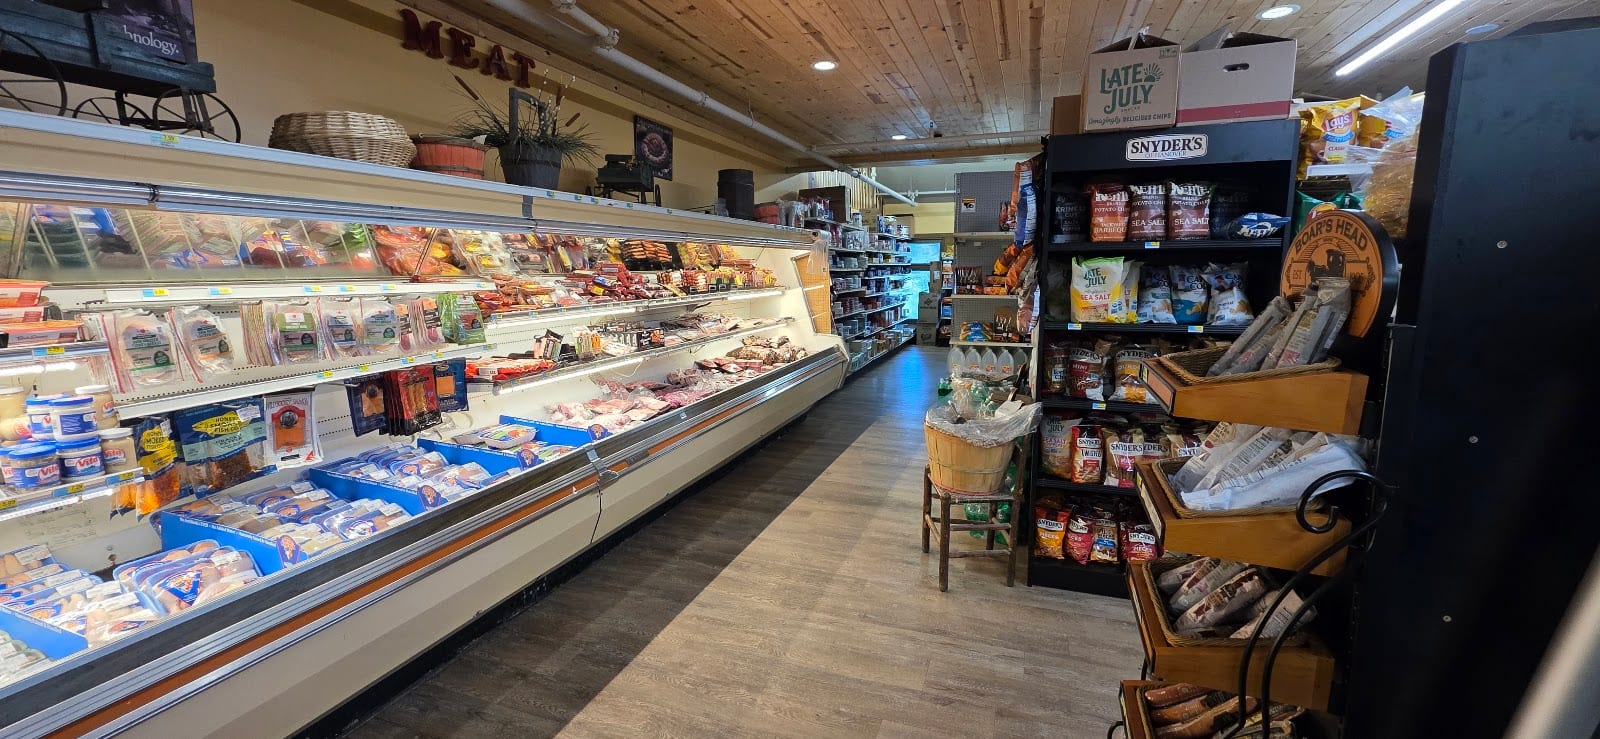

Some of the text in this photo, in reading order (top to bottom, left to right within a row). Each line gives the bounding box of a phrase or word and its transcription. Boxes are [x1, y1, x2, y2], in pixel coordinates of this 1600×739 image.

[398, 8, 536, 89] MEAT
[1100, 62, 1144, 94] LATE
[1103, 84, 1154, 114] JULY
[1122, 114, 1152, 123] DELICIOUS
[1153, 112, 1172, 120] CHIPS
[1131, 137, 1203, 154] SNYDER'S
[1131, 219, 1146, 227] SEA
[1174, 217, 1210, 226] SEA SALT
[1295, 218, 1368, 254] BOAR'S HEAD
[1084, 267, 1101, 280] LATE
[1085, 275, 1107, 288] JULY
[1080, 293, 1111, 301] SEA SALT
[76, 456, 99, 468] Vita
